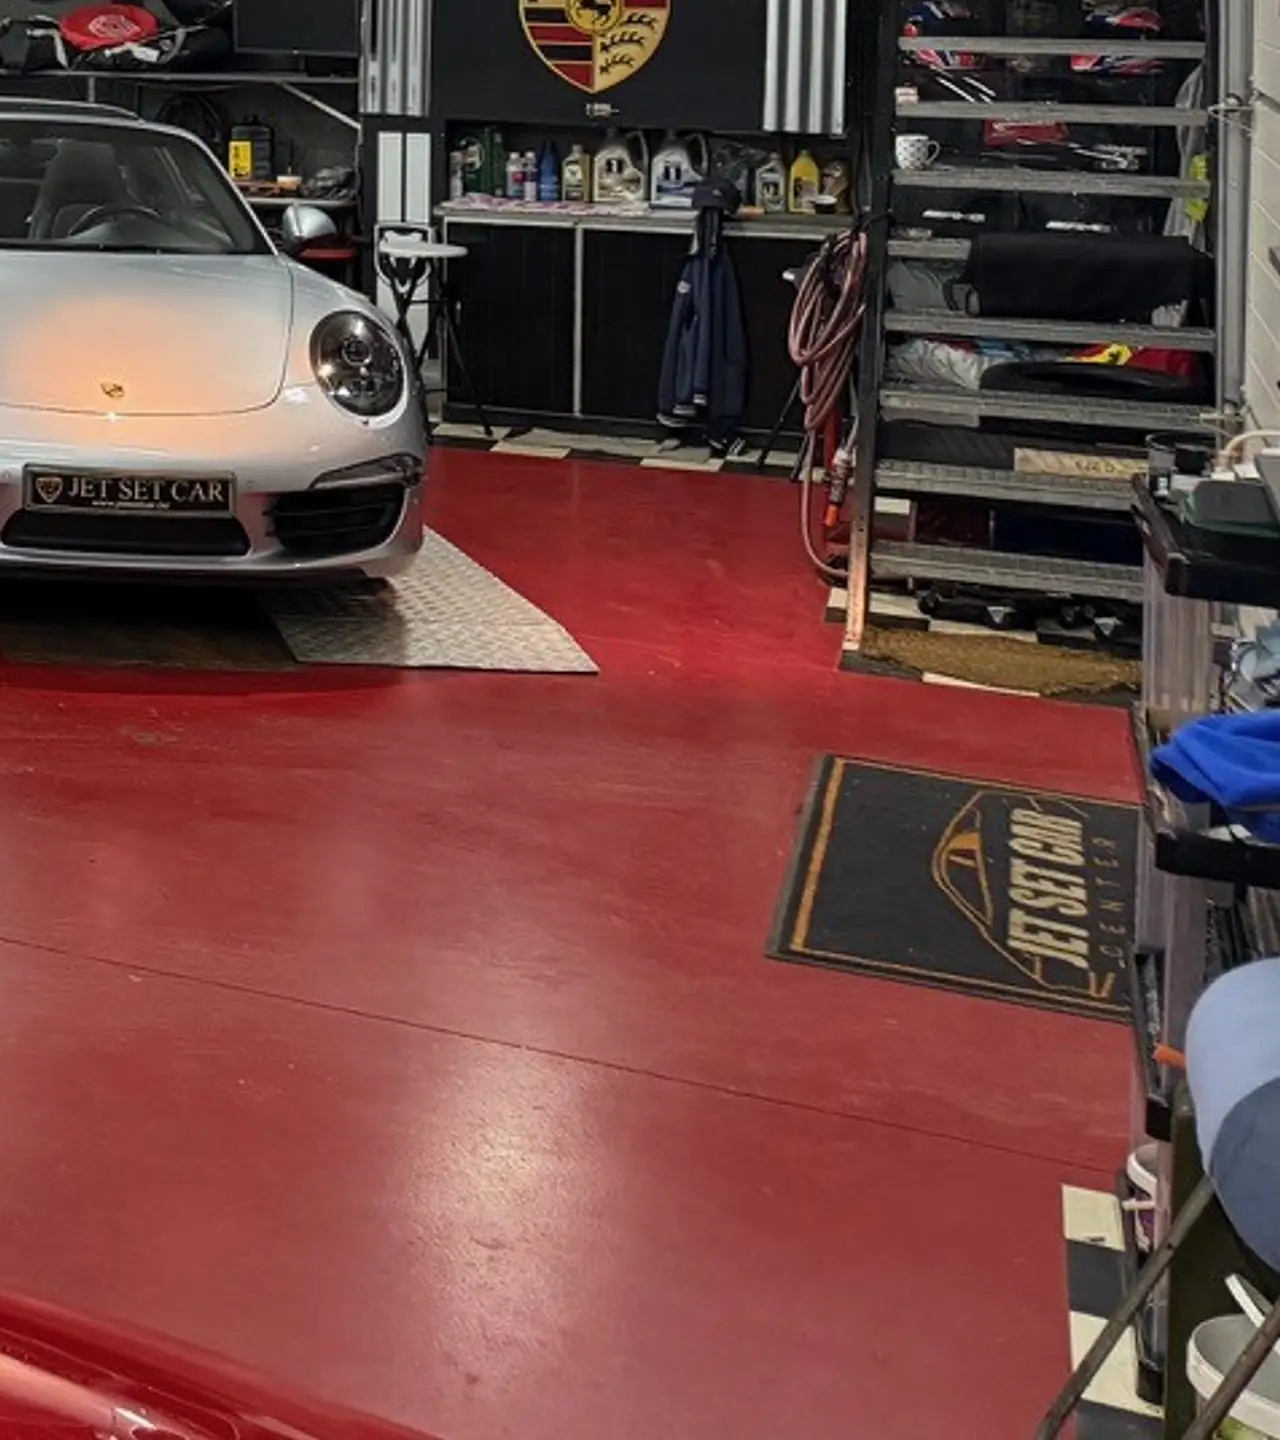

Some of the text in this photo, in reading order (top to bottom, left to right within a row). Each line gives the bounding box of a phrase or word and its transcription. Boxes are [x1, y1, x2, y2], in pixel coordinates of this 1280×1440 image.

[67, 476, 225, 503] JET SET CAR
[1007, 807, 1090, 970] JET SET CAR
[1090, 836, 1127, 960] CENTER
